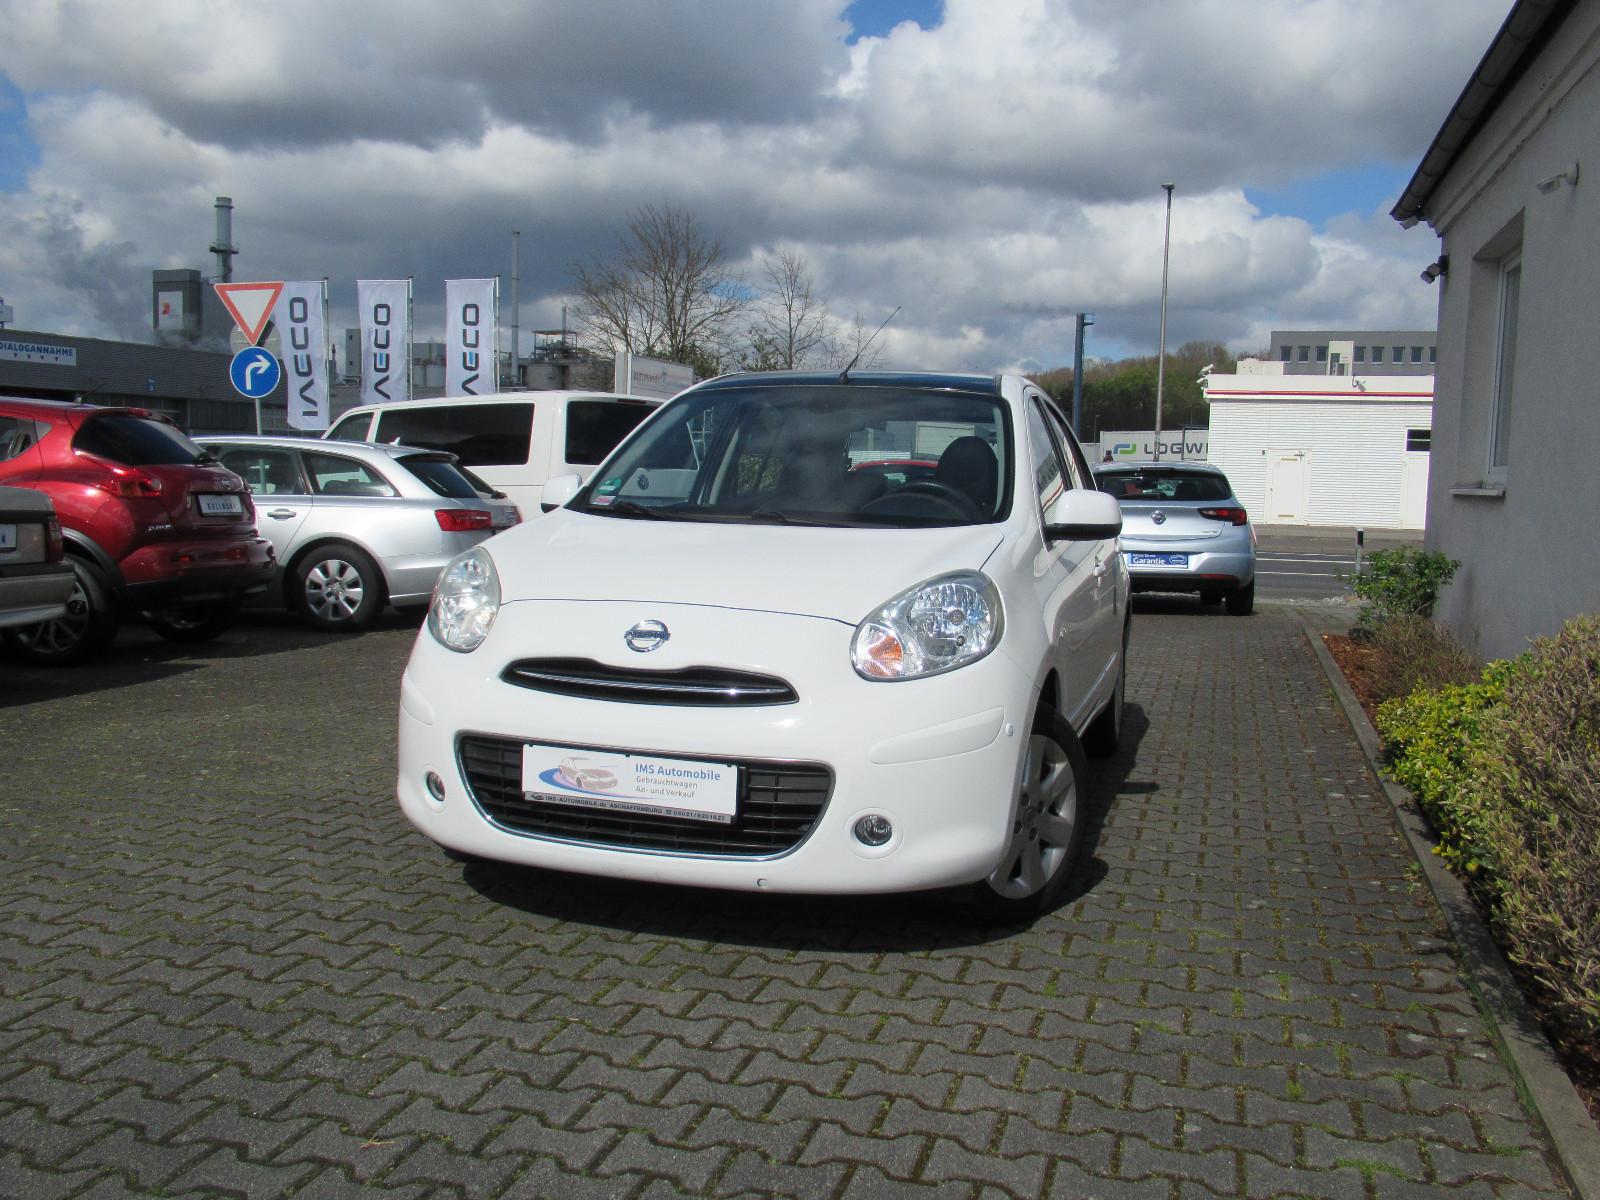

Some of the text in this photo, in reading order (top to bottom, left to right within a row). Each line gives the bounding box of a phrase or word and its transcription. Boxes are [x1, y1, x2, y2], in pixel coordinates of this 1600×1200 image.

[290, 297, 318, 416] IVECO
[1132, 557, 1166, 565] Garantie
[635, 763, 721, 780] IMS Automobile
[636, 775, 698, 789] Gebrauchtwagen
[635, 785, 695, 798] An- und Verkauf
